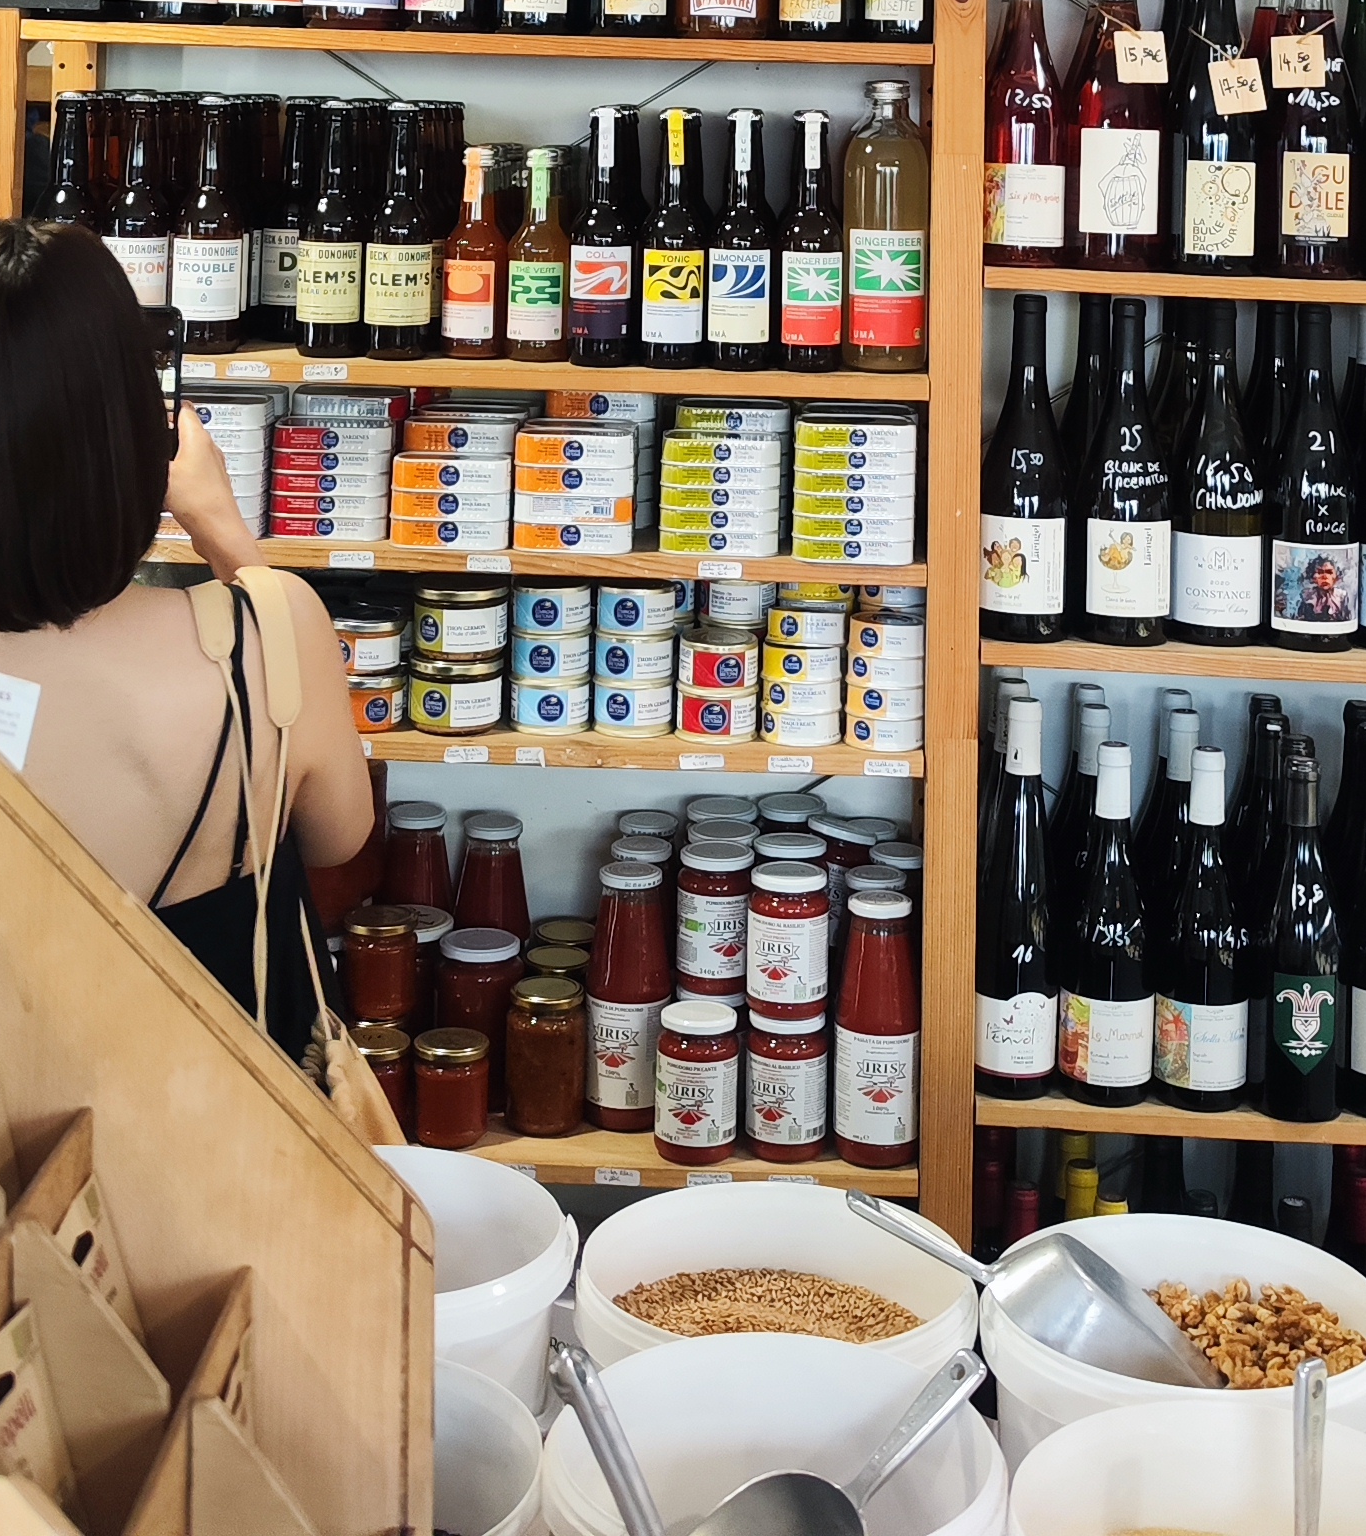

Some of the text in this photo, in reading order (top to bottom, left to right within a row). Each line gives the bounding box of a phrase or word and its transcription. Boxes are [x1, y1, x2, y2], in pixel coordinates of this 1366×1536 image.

[1192, 218, 1206, 226] LA
[1192, 219, 1225, 236] BULLE
[854, 235, 922, 248] GINGER BEER
[1192, 227, 1238, 253] FACTEUR
[369, 250, 431, 262] DECK DONOHUE
[585, 250, 617, 259] COLA
[661, 255, 691, 263] TONIC
[713, 253, 765, 263] LIMONADE
[787, 256, 841, 266] GINGER BEER
[177, 261, 236, 274] TROUBLE
[534, 265, 558, 273] VERT
[196, 276, 213, 287] #6
[296, 269, 356, 285] CLEM'S
[369, 270, 431, 287] CLEM'S
[341, 433, 370, 441] SARDINES
[1308, 430, 1335, 454] 21
[341, 455, 370, 463] SARDINES
[1306, 520, 1346, 535] ROUGE
[1185, 586, 1251, 600] CONSTANCE
[715, 919, 745, 932] IRIS
[761, 942, 792, 955] IRIS
[1012, 944, 1033, 963] 16
[599, 1027, 630, 1041] IRIS
[865, 1062, 898, 1075] IRIS
[756, 1081, 786, 1095] IRIS
